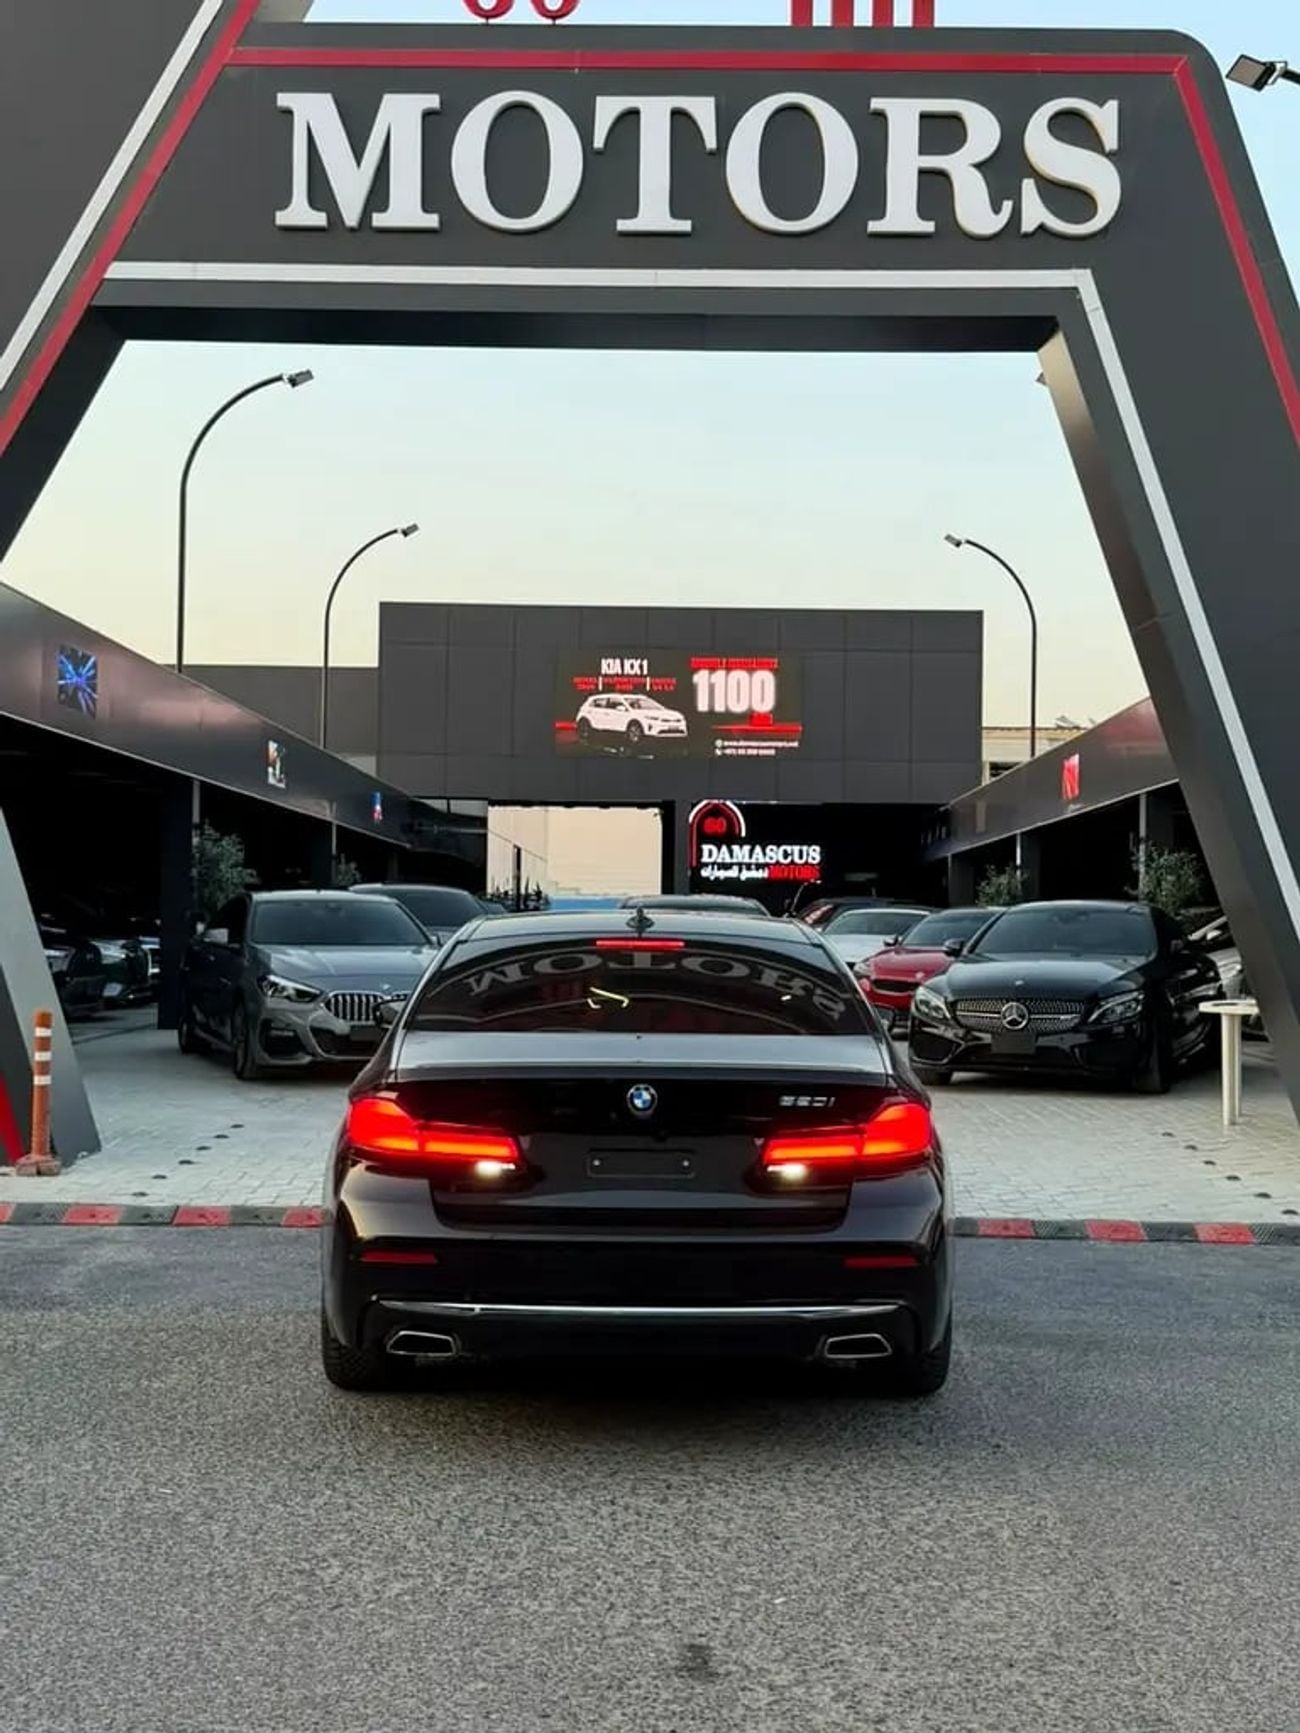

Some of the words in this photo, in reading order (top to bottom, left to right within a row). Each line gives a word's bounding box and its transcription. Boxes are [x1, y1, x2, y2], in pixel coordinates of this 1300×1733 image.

[274, 90, 1122, 238] MOTORS
[601, 658, 621, 675] KIA
[692, 669, 776, 713] 1100
[701, 844, 821, 864] DAMASCUS
